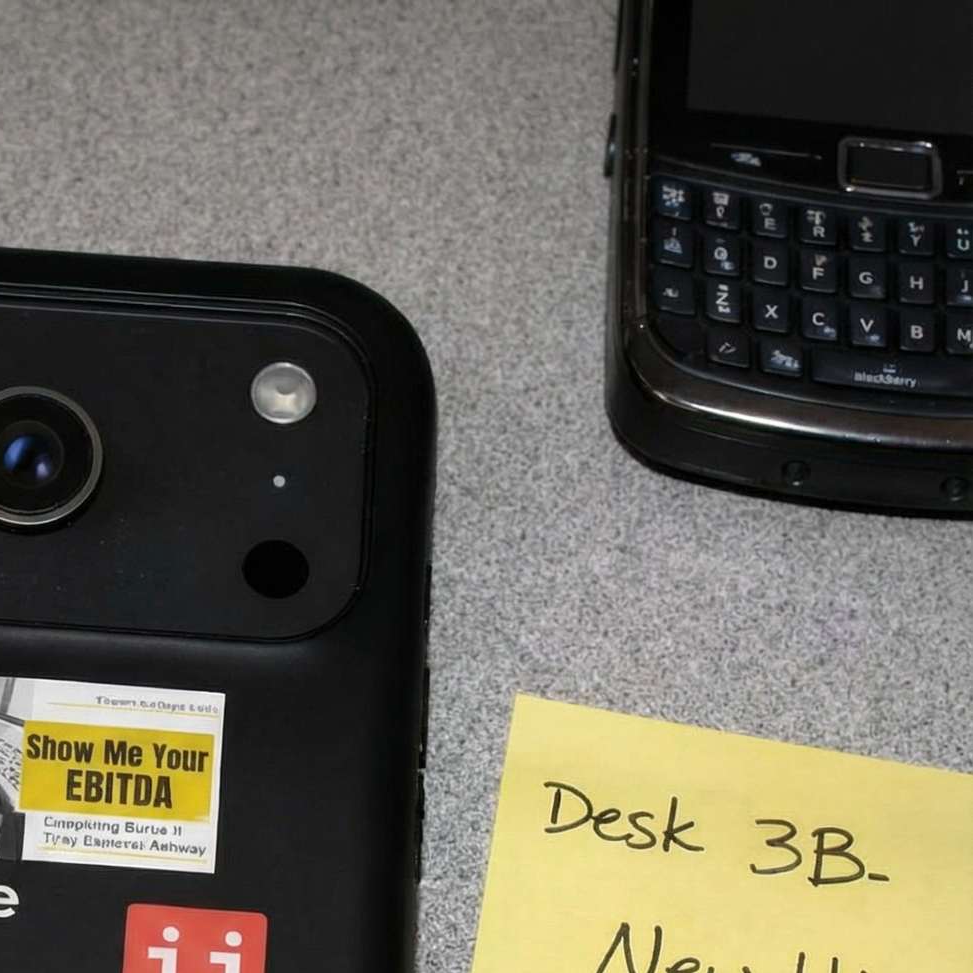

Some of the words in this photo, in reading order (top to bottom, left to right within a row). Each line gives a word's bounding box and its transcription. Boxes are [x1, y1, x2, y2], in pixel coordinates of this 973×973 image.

[813, 226, 825, 238] R
[764, 256, 777, 269] D
[813, 268, 824, 280] F
[859, 272, 873, 284] G
[910, 276, 924, 290] H
[765, 305, 778, 319] X
[812, 313, 825, 326] C
[860, 318, 874, 333] V
[910, 325, 924, 339] B
[957, 328, 971, 343] M
[27, 734, 94, 764] Show
[104, 739, 143, 767] Me
[153, 743, 209, 772] Your
[66, 769, 173, 809] EBITDA
[543, 781, 705, 853] Desk
